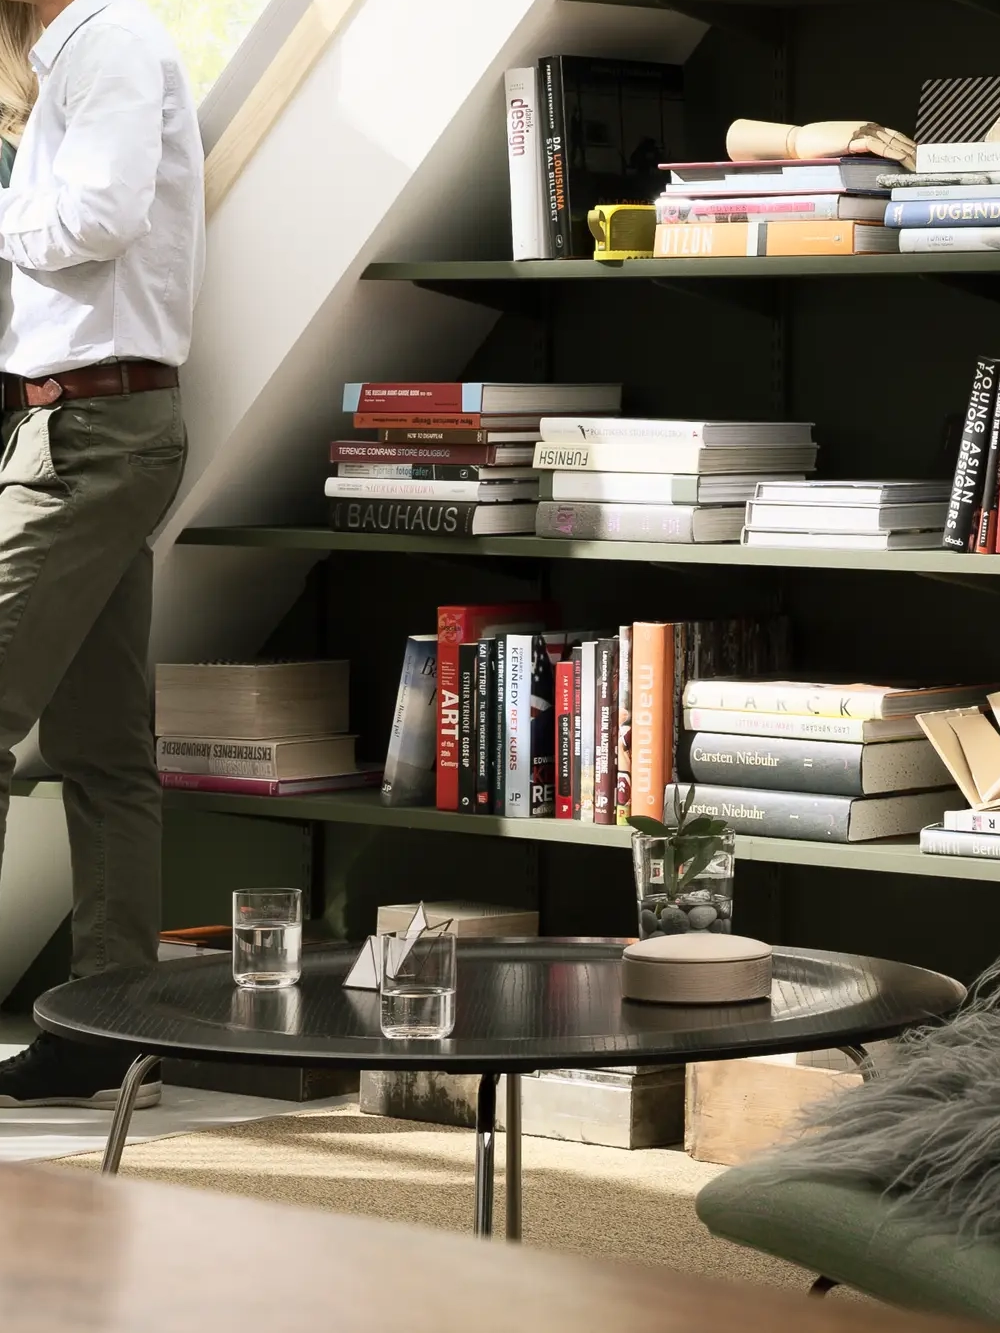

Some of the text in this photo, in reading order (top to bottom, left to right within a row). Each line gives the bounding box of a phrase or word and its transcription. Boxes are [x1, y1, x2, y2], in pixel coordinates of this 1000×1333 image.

[509, 98, 529, 157] design
[525, 108, 534, 130] dansk
[926, 153, 962, 164] Masters
[964, 152, 974, 161] of
[545, 137, 558, 223] STJAL BILLEDET
[552, 136, 565, 211] DA LOUISIANA
[661, 226, 714, 254] UTZON
[961, 364, 995, 504] YOUNG ASIAN
[990, 429, 999, 450] WORLD
[339, 447, 451, 458] TERENCE CONRANS STORE BOLIGBOG
[946, 361, 986, 529] FASHION DESIGNERS
[538, 450, 589, 466] FURNISH
[372, 466, 395, 476] Fjorten
[395, 465, 430, 477] fotografer
[347, 503, 459, 532] BAUHAUS
[556, 504, 575, 536] ART
[944, 535, 964, 547] daab
[479, 642, 487, 657] KAI
[479, 661, 487, 696] VITTRUP
[496, 659, 504, 703] TERKELSEN
[440, 689, 460, 741] ART
[508, 646, 519, 771] KENNEDY RET KURS
[461, 671, 470, 768] ESTHER VERHOEF CLOSE-UP
[833, 725, 850, 735] LARS
[213, 744, 272, 762] EKSTREMERNES
[600, 732, 609, 774] NAZISTERNE
[693, 747, 780, 767] Carsten Niebuhr
[256, 763, 273, 777] ERIC
[440, 759, 459, 769] Century
[509, 792, 522, 802] JP
[595, 795, 608, 808] JP
[721, 803, 766, 820] Niebuhr
